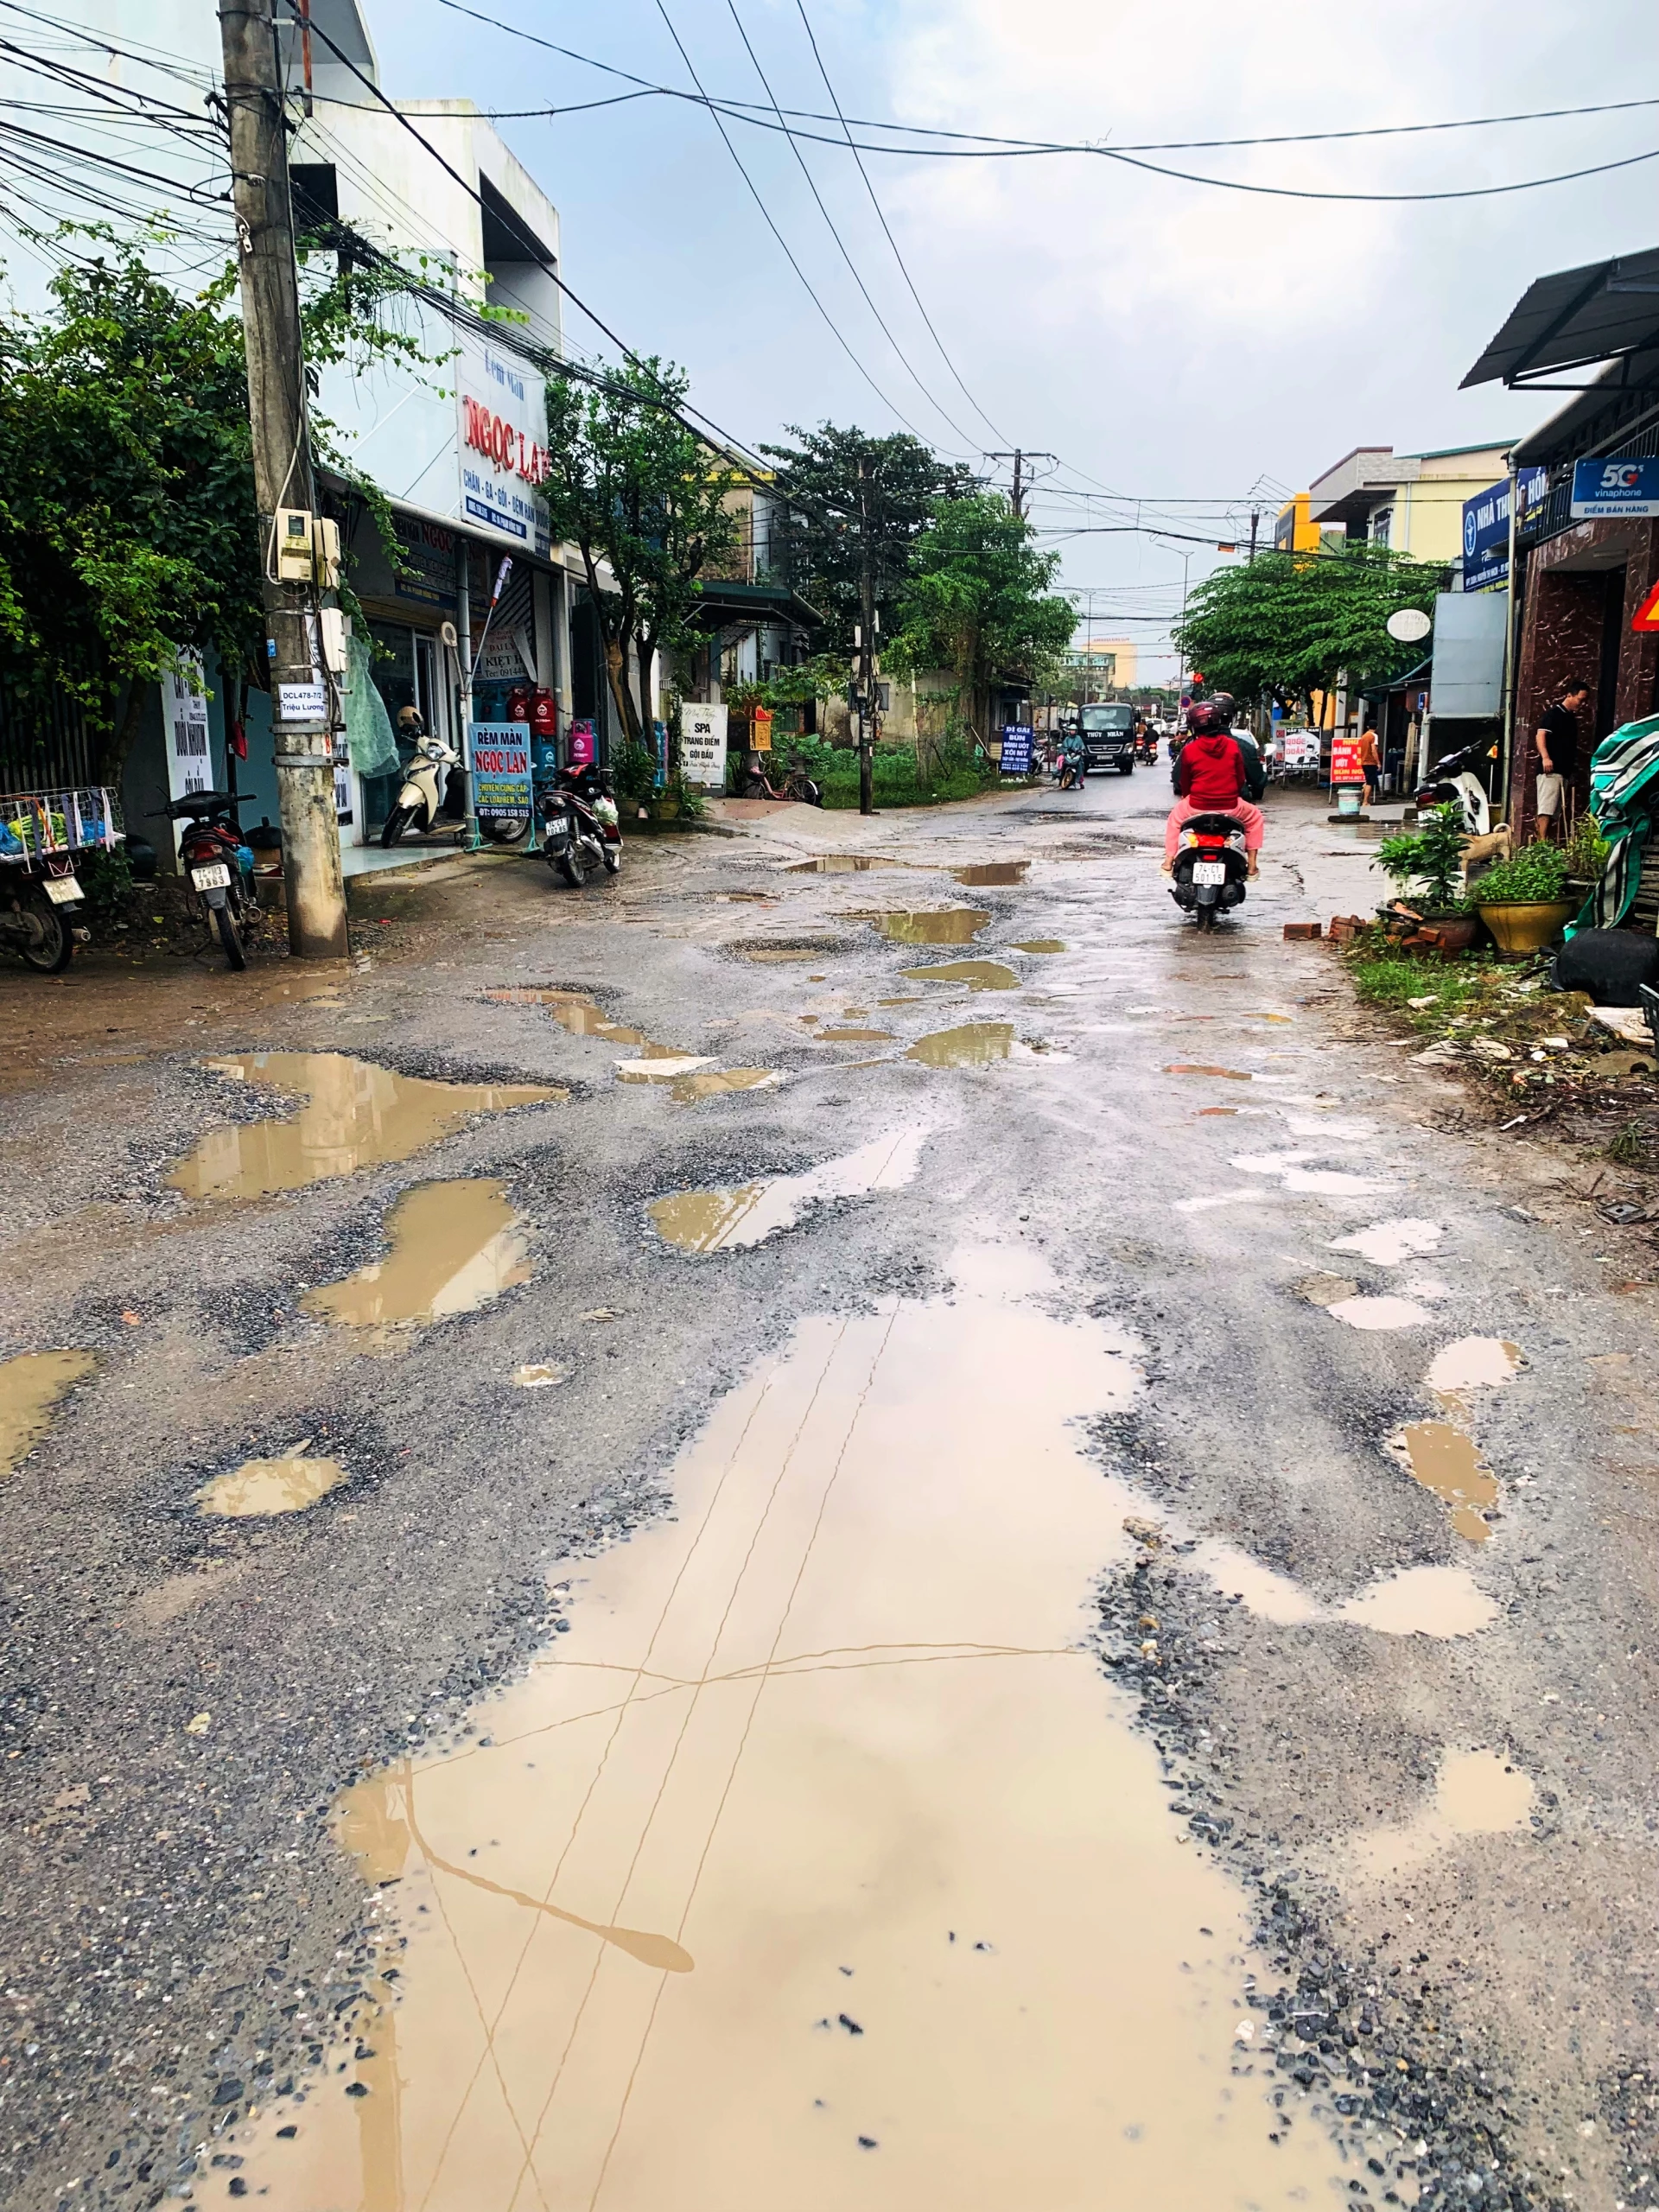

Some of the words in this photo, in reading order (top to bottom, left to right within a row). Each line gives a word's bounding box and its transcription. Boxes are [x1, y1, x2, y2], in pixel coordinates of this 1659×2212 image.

[463, 395, 515, 473] NGỌC
[1594, 488, 1643, 499] vinaphone
[1477, 498, 1495, 531] NHÀ
[1584, 504, 1605, 514] ĐIỂM
[283, 703, 301, 712] Triệu
[302, 703, 324, 712] Lương
[694, 722, 711, 734] SPA
[477, 727, 499, 745] RÈM
[500, 728, 523, 746] MÀN
[683, 736, 703, 746] TRANG
[474, 750, 504, 779] NGỌC
[506, 751, 528, 773] LAN
[478, 783, 499, 792] CHUYÊN
[500, 784, 517, 792] CUNG
[490, 808, 507, 817] 0905
[519, 809, 530, 817] 515
